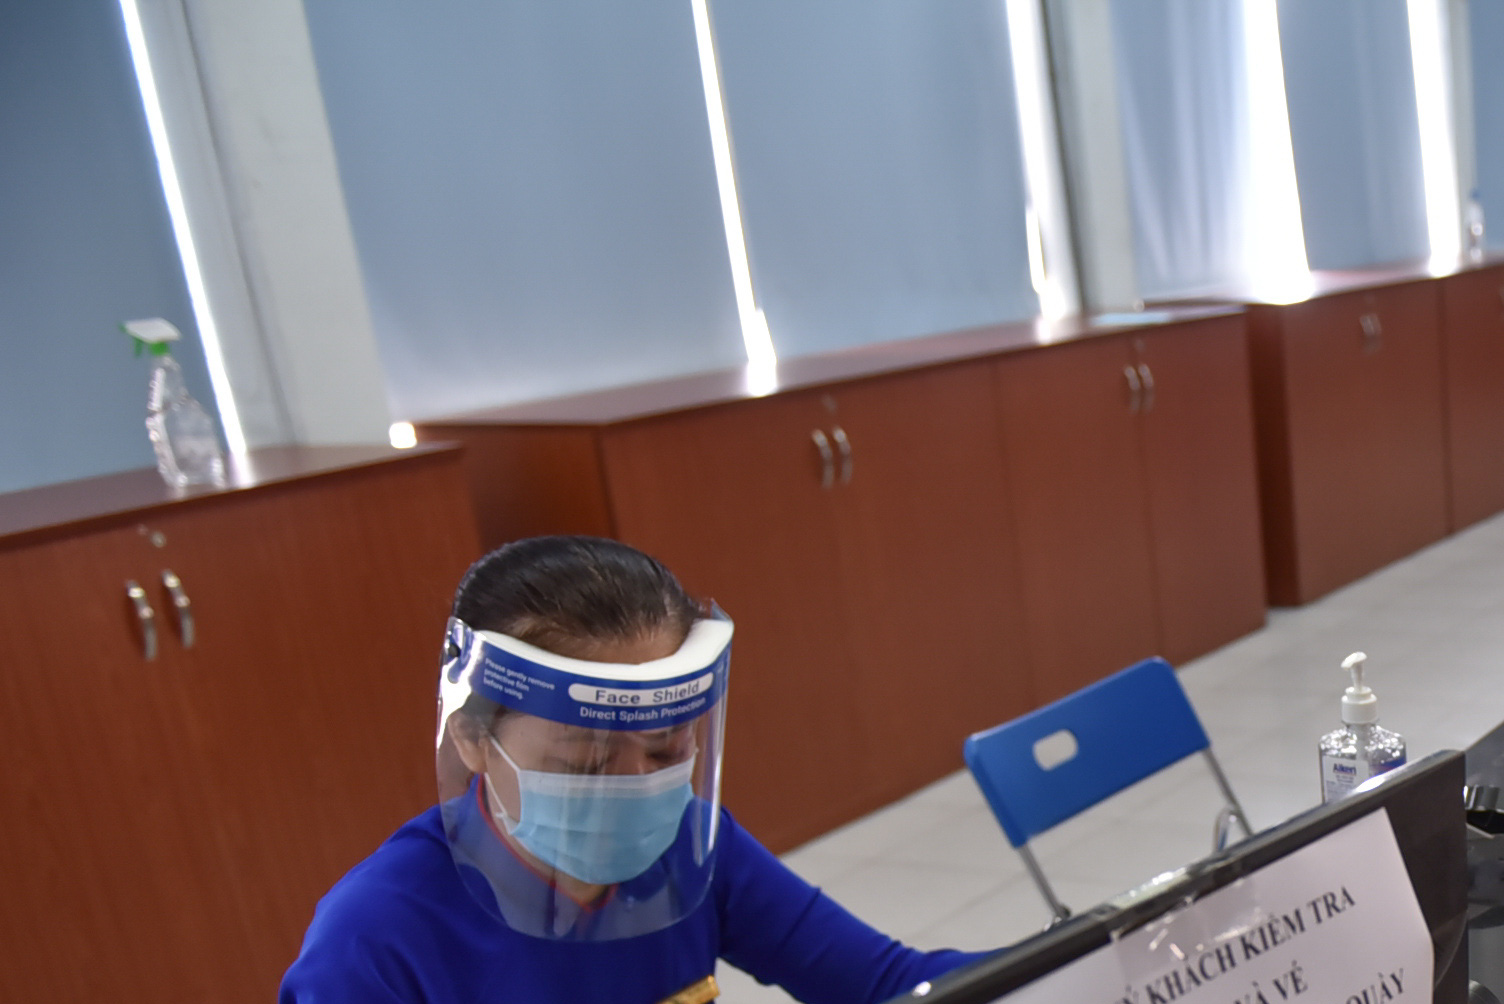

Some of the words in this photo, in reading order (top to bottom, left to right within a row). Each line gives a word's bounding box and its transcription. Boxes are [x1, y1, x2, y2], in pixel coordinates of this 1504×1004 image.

[483, 676, 503, 691] before
[484, 668, 515, 686] protective
[516, 681, 529, 691] film
[485, 658, 505, 673] Please
[506, 669, 527, 682] gently
[528, 677, 555, 690] remove
[595, 689, 641, 704] Face
[652, 681, 700, 703] Shield
[580, 706, 616, 720] Direct
[619, 709, 659, 723] Splash
[661, 697, 706, 718] Protection
[1238, 909, 1306, 962] KIỂM
[1307, 885, 1356, 926] TRA
